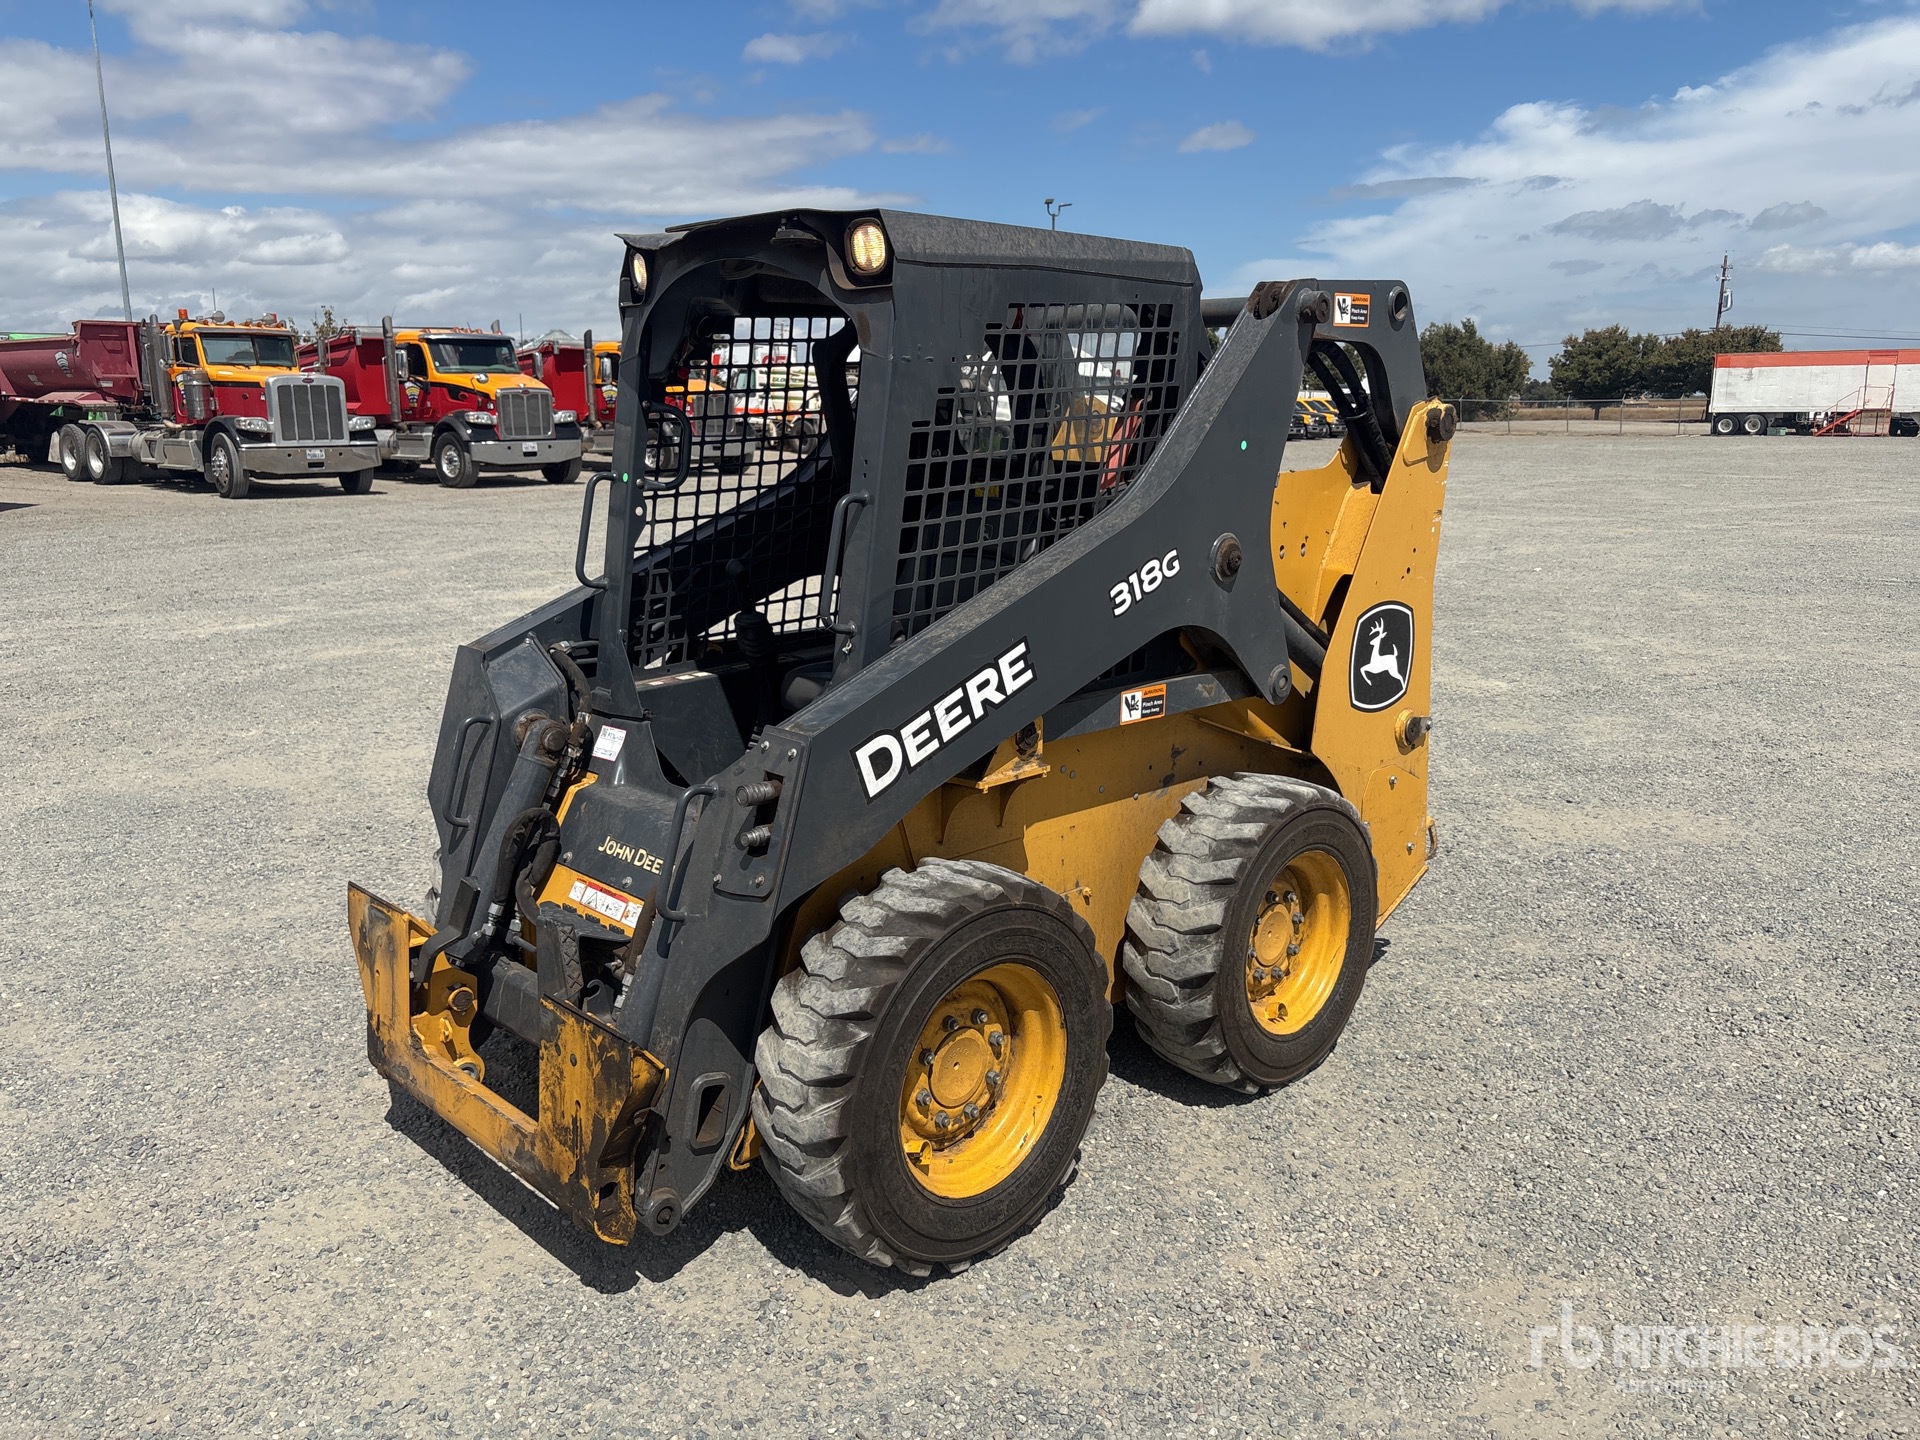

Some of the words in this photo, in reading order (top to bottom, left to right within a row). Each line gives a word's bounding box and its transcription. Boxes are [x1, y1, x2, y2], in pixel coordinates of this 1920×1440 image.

[1109, 549, 1180, 616] 318G
[855, 642, 1034, 798] DEERE
[597, 835, 635, 863] JOHN
[633, 848, 664, 875] DEE
